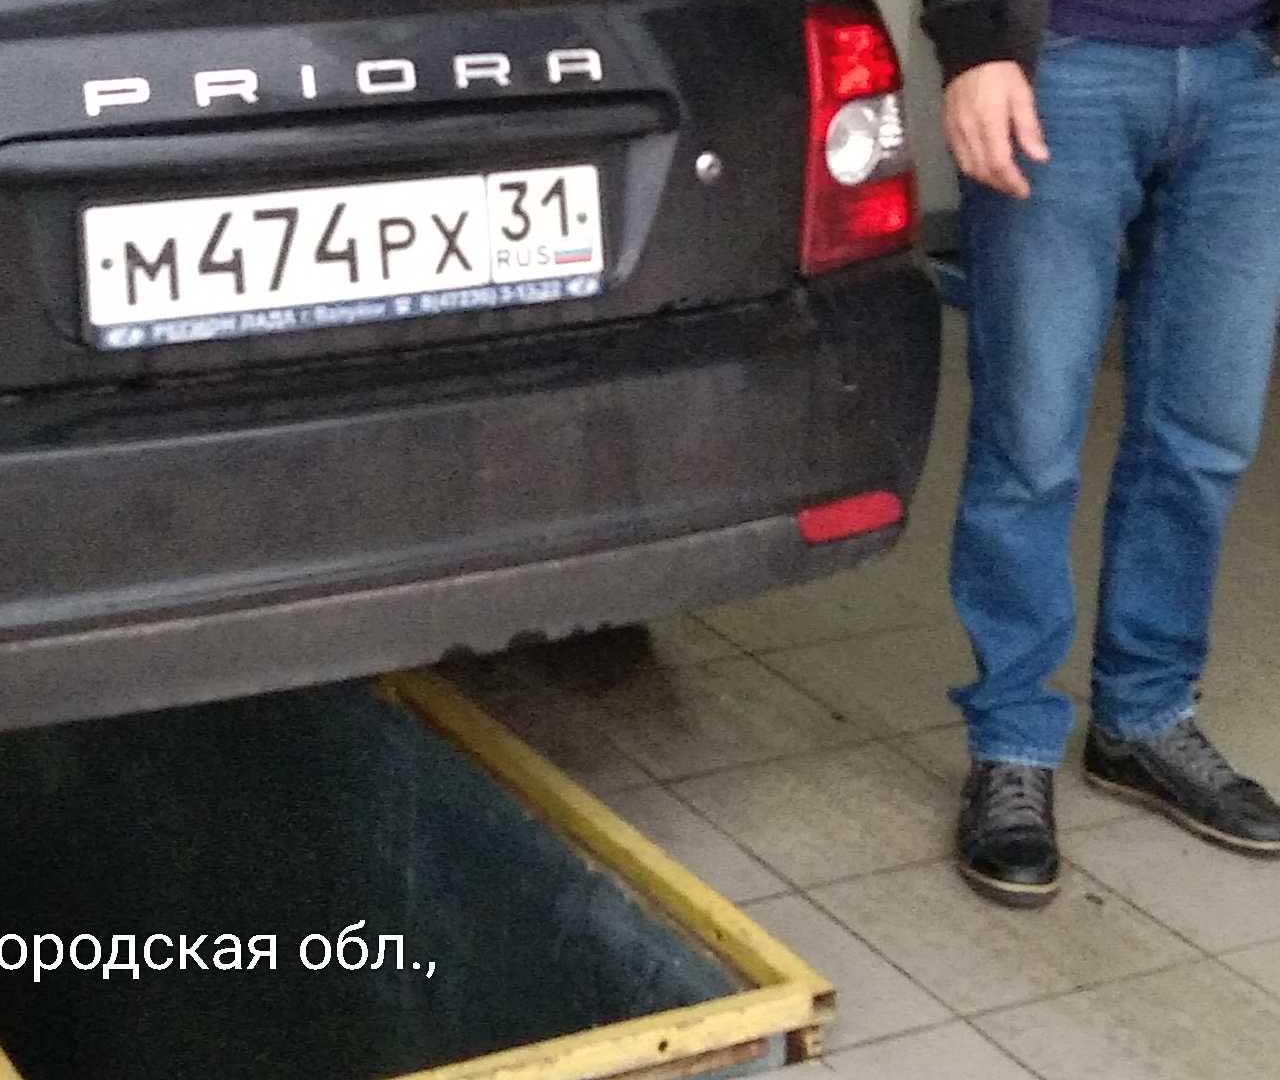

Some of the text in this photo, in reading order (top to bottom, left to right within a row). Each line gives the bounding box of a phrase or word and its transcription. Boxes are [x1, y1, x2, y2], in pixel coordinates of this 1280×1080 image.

[82, 48, 603, 117] PRIORA
[124, 177, 568, 306] М474РХ 31
[497, 245, 550, 267] RUS
